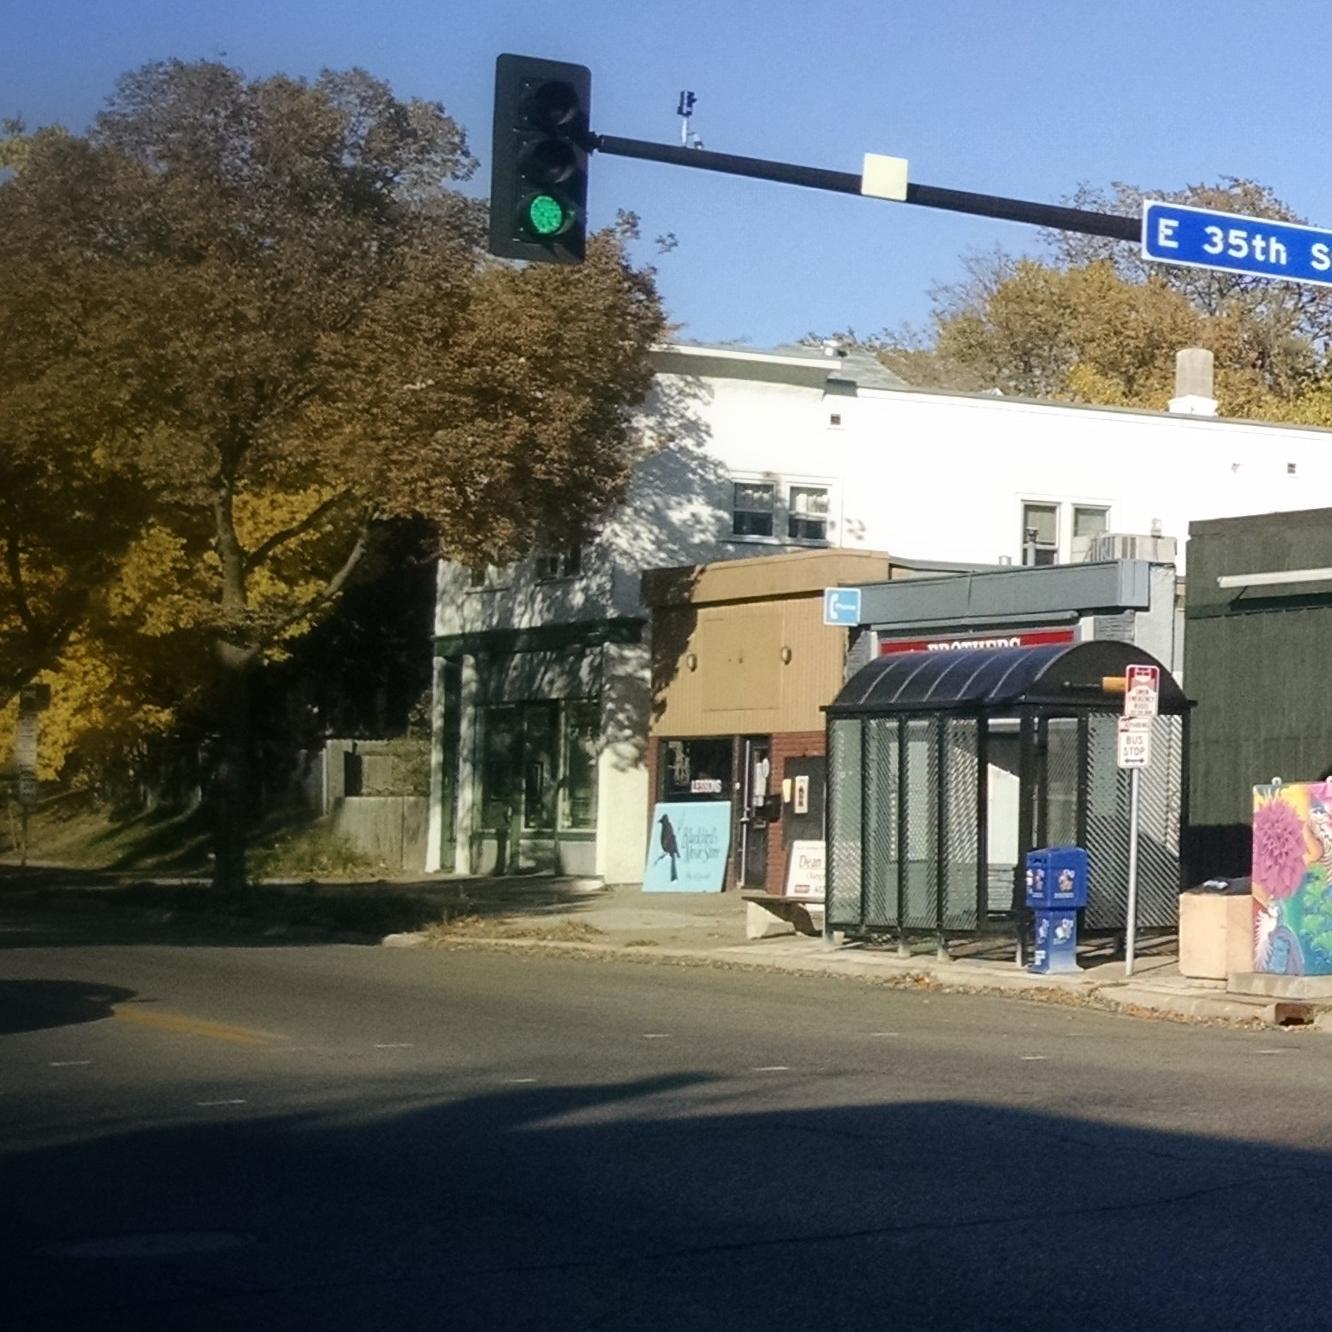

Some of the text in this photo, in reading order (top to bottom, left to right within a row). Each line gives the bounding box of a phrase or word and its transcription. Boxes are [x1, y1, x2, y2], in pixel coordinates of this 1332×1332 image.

[1157, 217, 1180, 249] E
[1203, 225, 1288, 265] 35th
[1125, 735, 1144, 745] BUS
[1123, 746, 1146, 757] STOP
[690, 779, 722, 793] LESSONS
